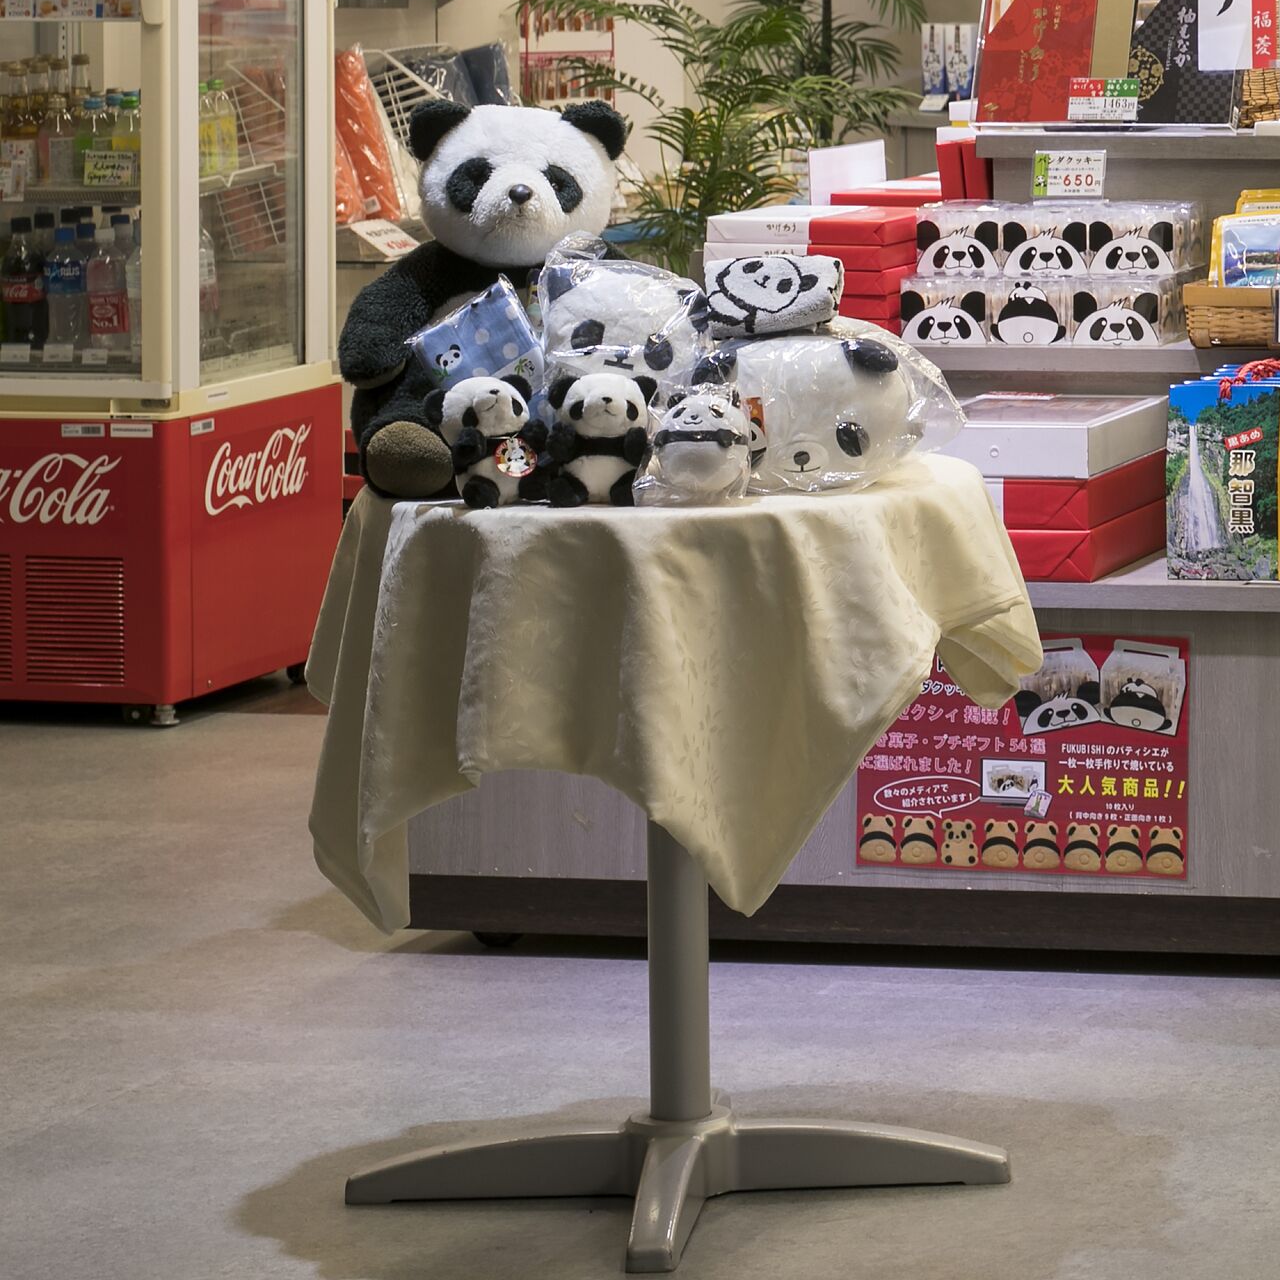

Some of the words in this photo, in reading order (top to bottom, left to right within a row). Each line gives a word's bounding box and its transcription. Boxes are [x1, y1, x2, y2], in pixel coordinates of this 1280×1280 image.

[1172, 6, 1197, 68] 柚もなか
[1253, 10, 1272, 57] 福菱
[1038, 155, 1102, 165] パンダクッキー
[766, 224, 797, 233] かげろう
[1228, 428, 1261, 448] 黒あめ
[204, 423, 312, 516] Coca-Cola
[1228, 449, 1255, 534] 那智黒
[964, 706, 1011, 727] 掲載！
[1009, 740, 1027, 754] 54
[1030, 738, 1047, 756] 選
[1061, 743, 1170, 759] FUKUBISHIのパティシエが
[860, 756, 973, 774] に選ばれました！
[1058, 758, 1176, 773] 一枚一枚手作りで焼いている
[884, 783, 950, 800] 数々のメディアで
[1057, 774, 1187, 800] 大人気商品！！
[901, 791, 975, 809] 紹介されています！
